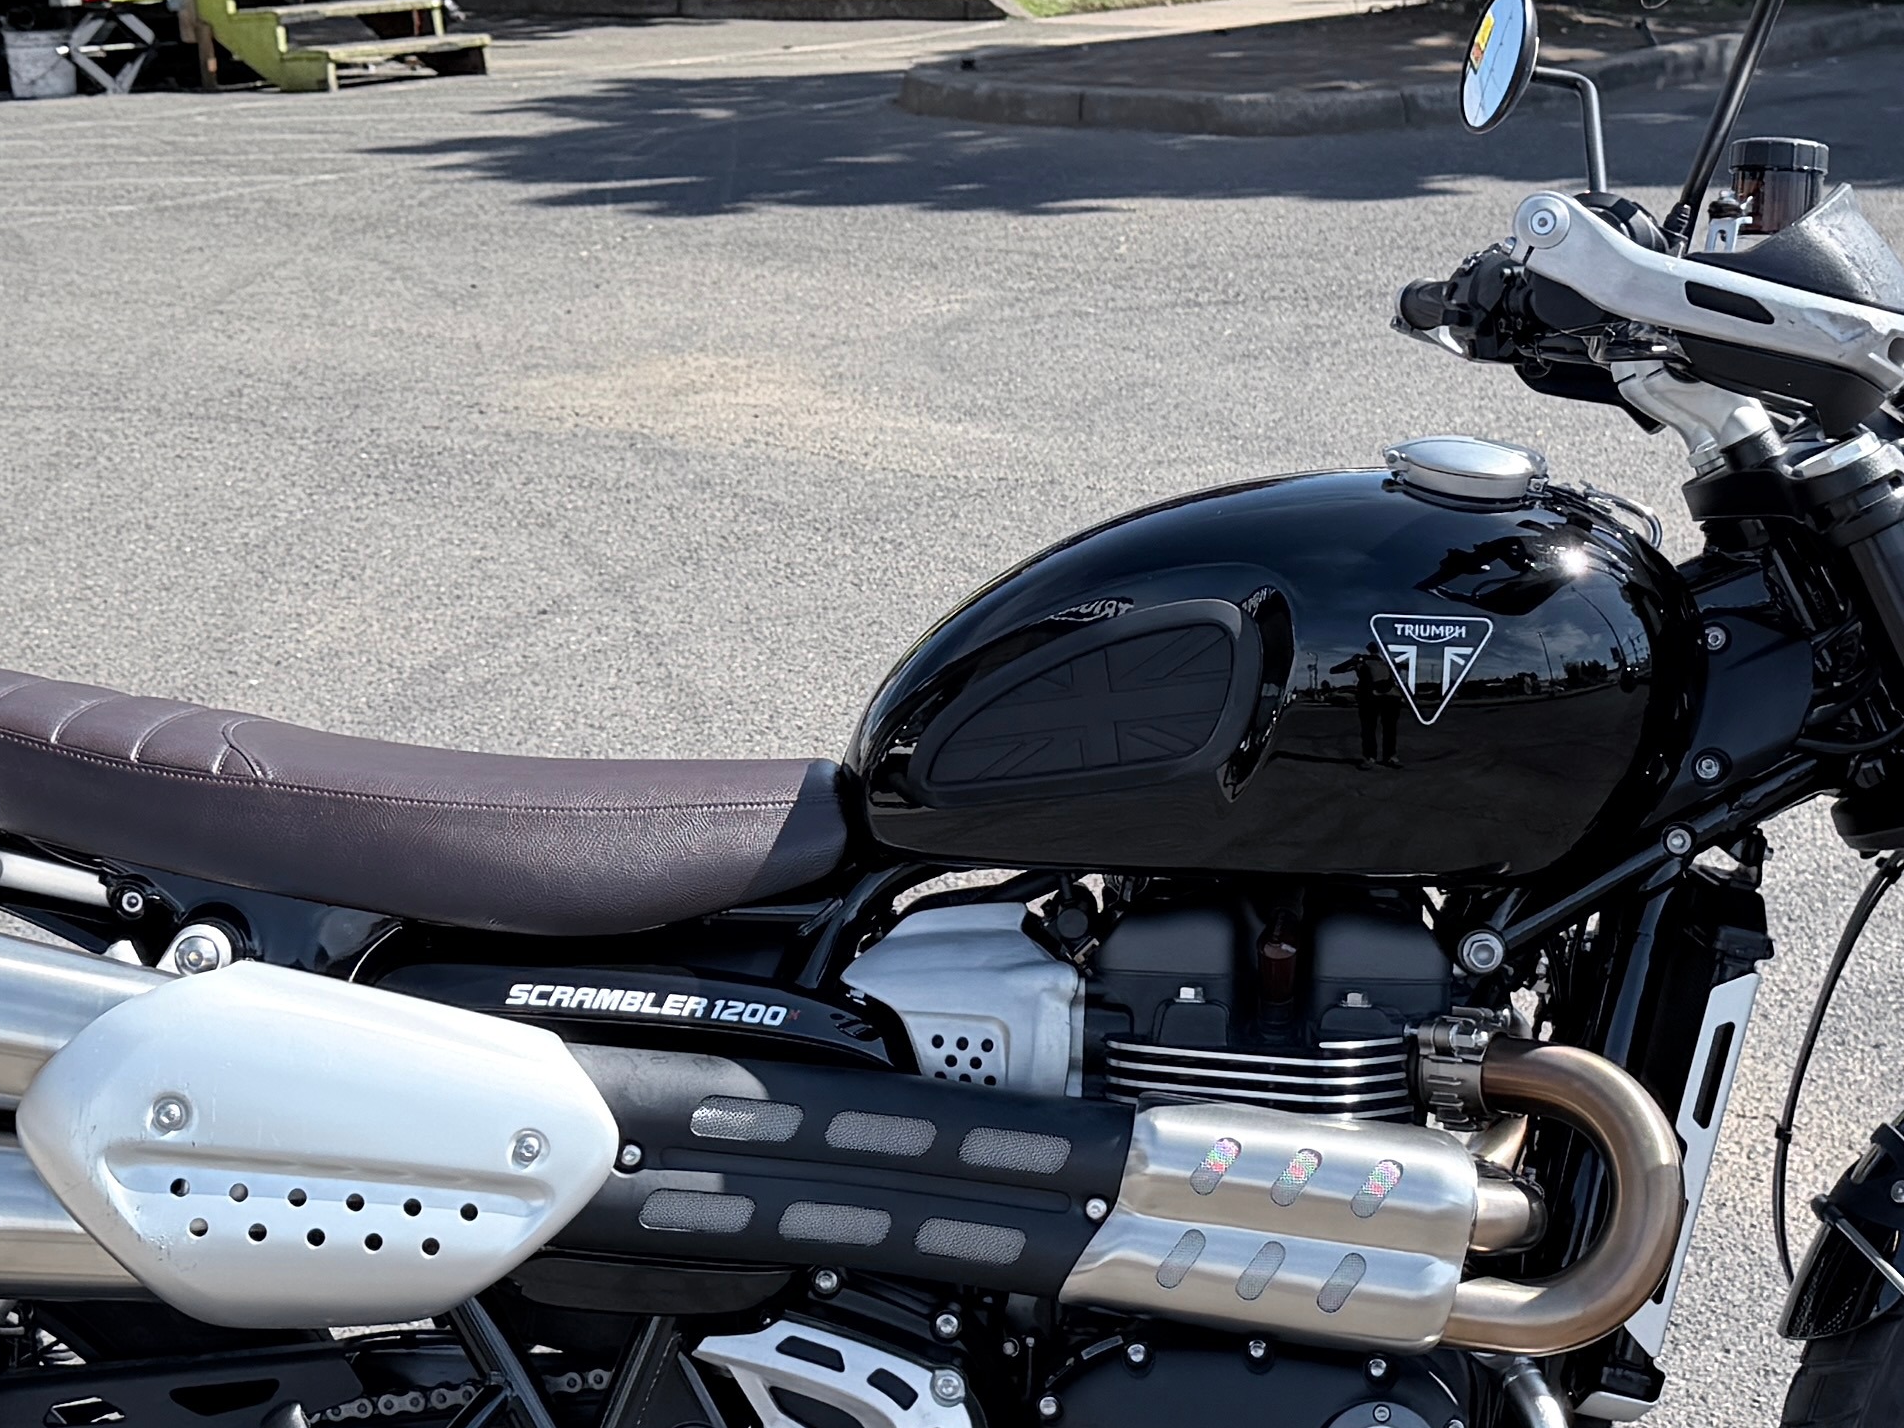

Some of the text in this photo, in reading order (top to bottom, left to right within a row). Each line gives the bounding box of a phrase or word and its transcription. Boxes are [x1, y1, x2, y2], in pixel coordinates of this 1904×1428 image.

[1394, 623, 1467, 640] TRIUMPH
[505, 983, 707, 1019] SCRAMBLER
[710, 998, 787, 1027] 1200
